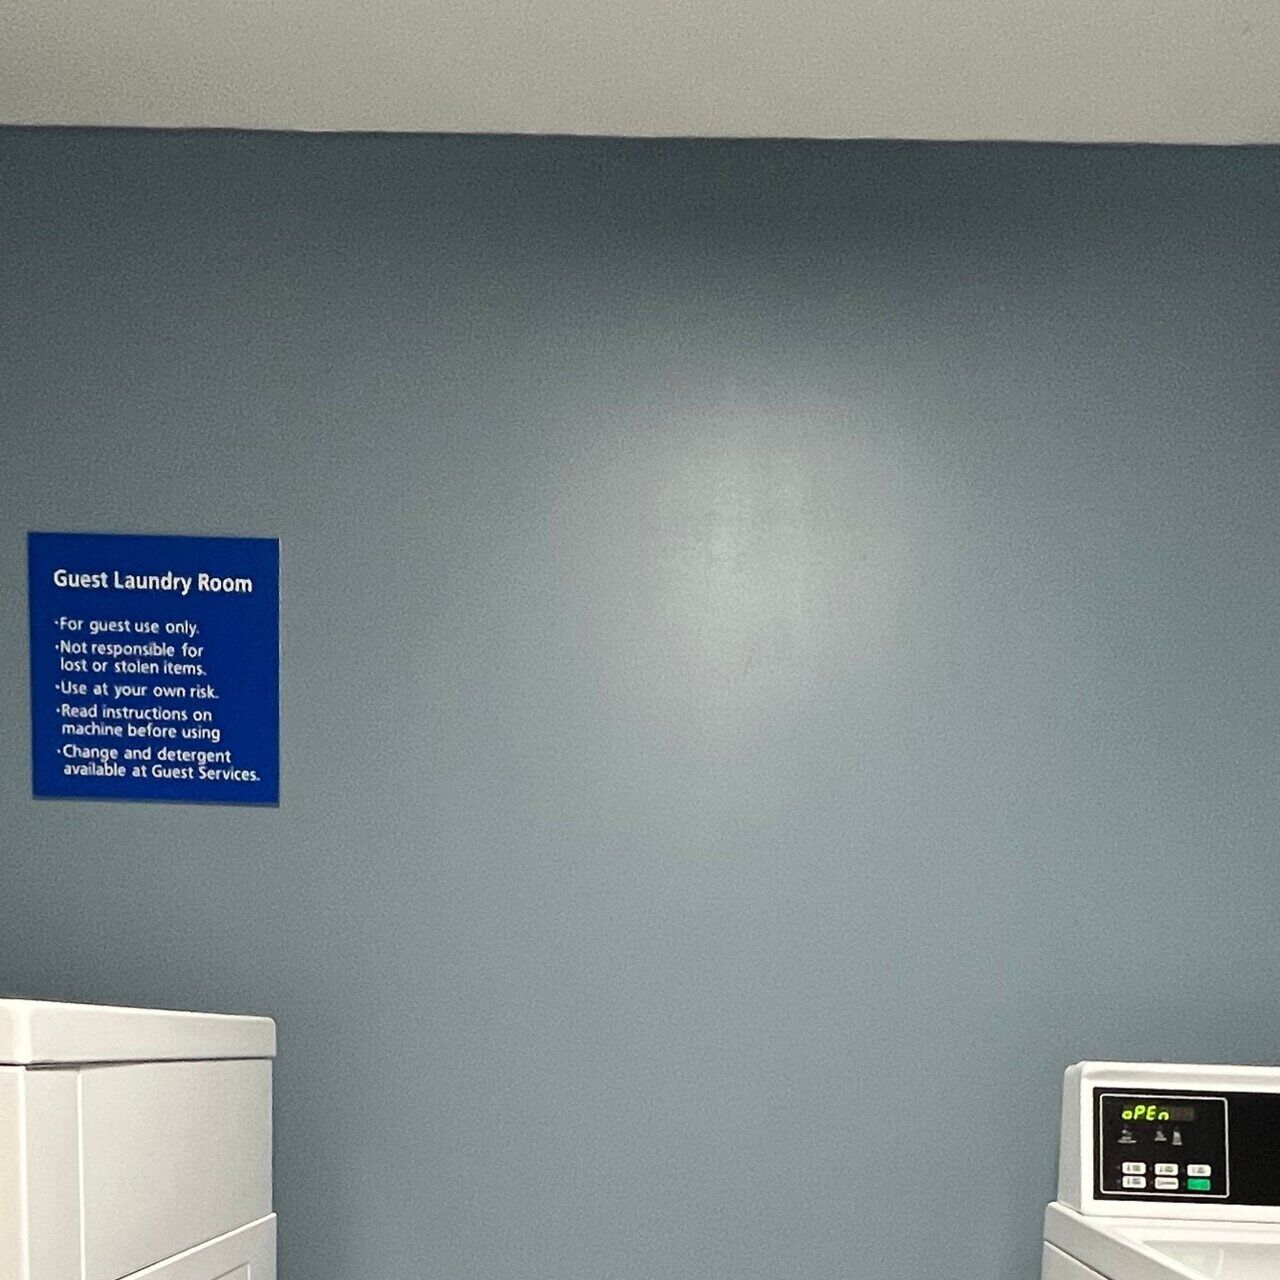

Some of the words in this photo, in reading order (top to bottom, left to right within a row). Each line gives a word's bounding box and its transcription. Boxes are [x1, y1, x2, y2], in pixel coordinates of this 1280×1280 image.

[54, 569, 108, 588] Guest
[114, 571, 192, 596] Laundry
[198, 573, 253, 592] Room
[89, 620, 130, 634] guest
[134, 622, 159, 633] use
[165, 621, 199, 637] only.
[91, 642, 174, 658] responsible
[181, 643, 204, 657] for
[60, 658, 88, 672] lost
[93, 661, 107, 672] or
[114, 660, 159, 674] stolen
[164, 661, 207, 676] items.
[93, 683, 108, 696] at
[114, 686, 147, 699] your
[153, 686, 185, 698] own
[190, 685, 219, 699] risk.
[103, 704, 187, 720] instructions
[193, 709, 212, 721] on
[62, 722, 123, 737] machine
[128, 724, 177, 739] before
[182, 726, 220, 743] using
[124, 746, 151, 760] and
[157, 747, 231, 764] detergent
[64, 762, 126, 777] available
[132, 766, 147, 778] at
[151, 764, 193, 780] Guest
[198, 766, 260, 781] Services.
